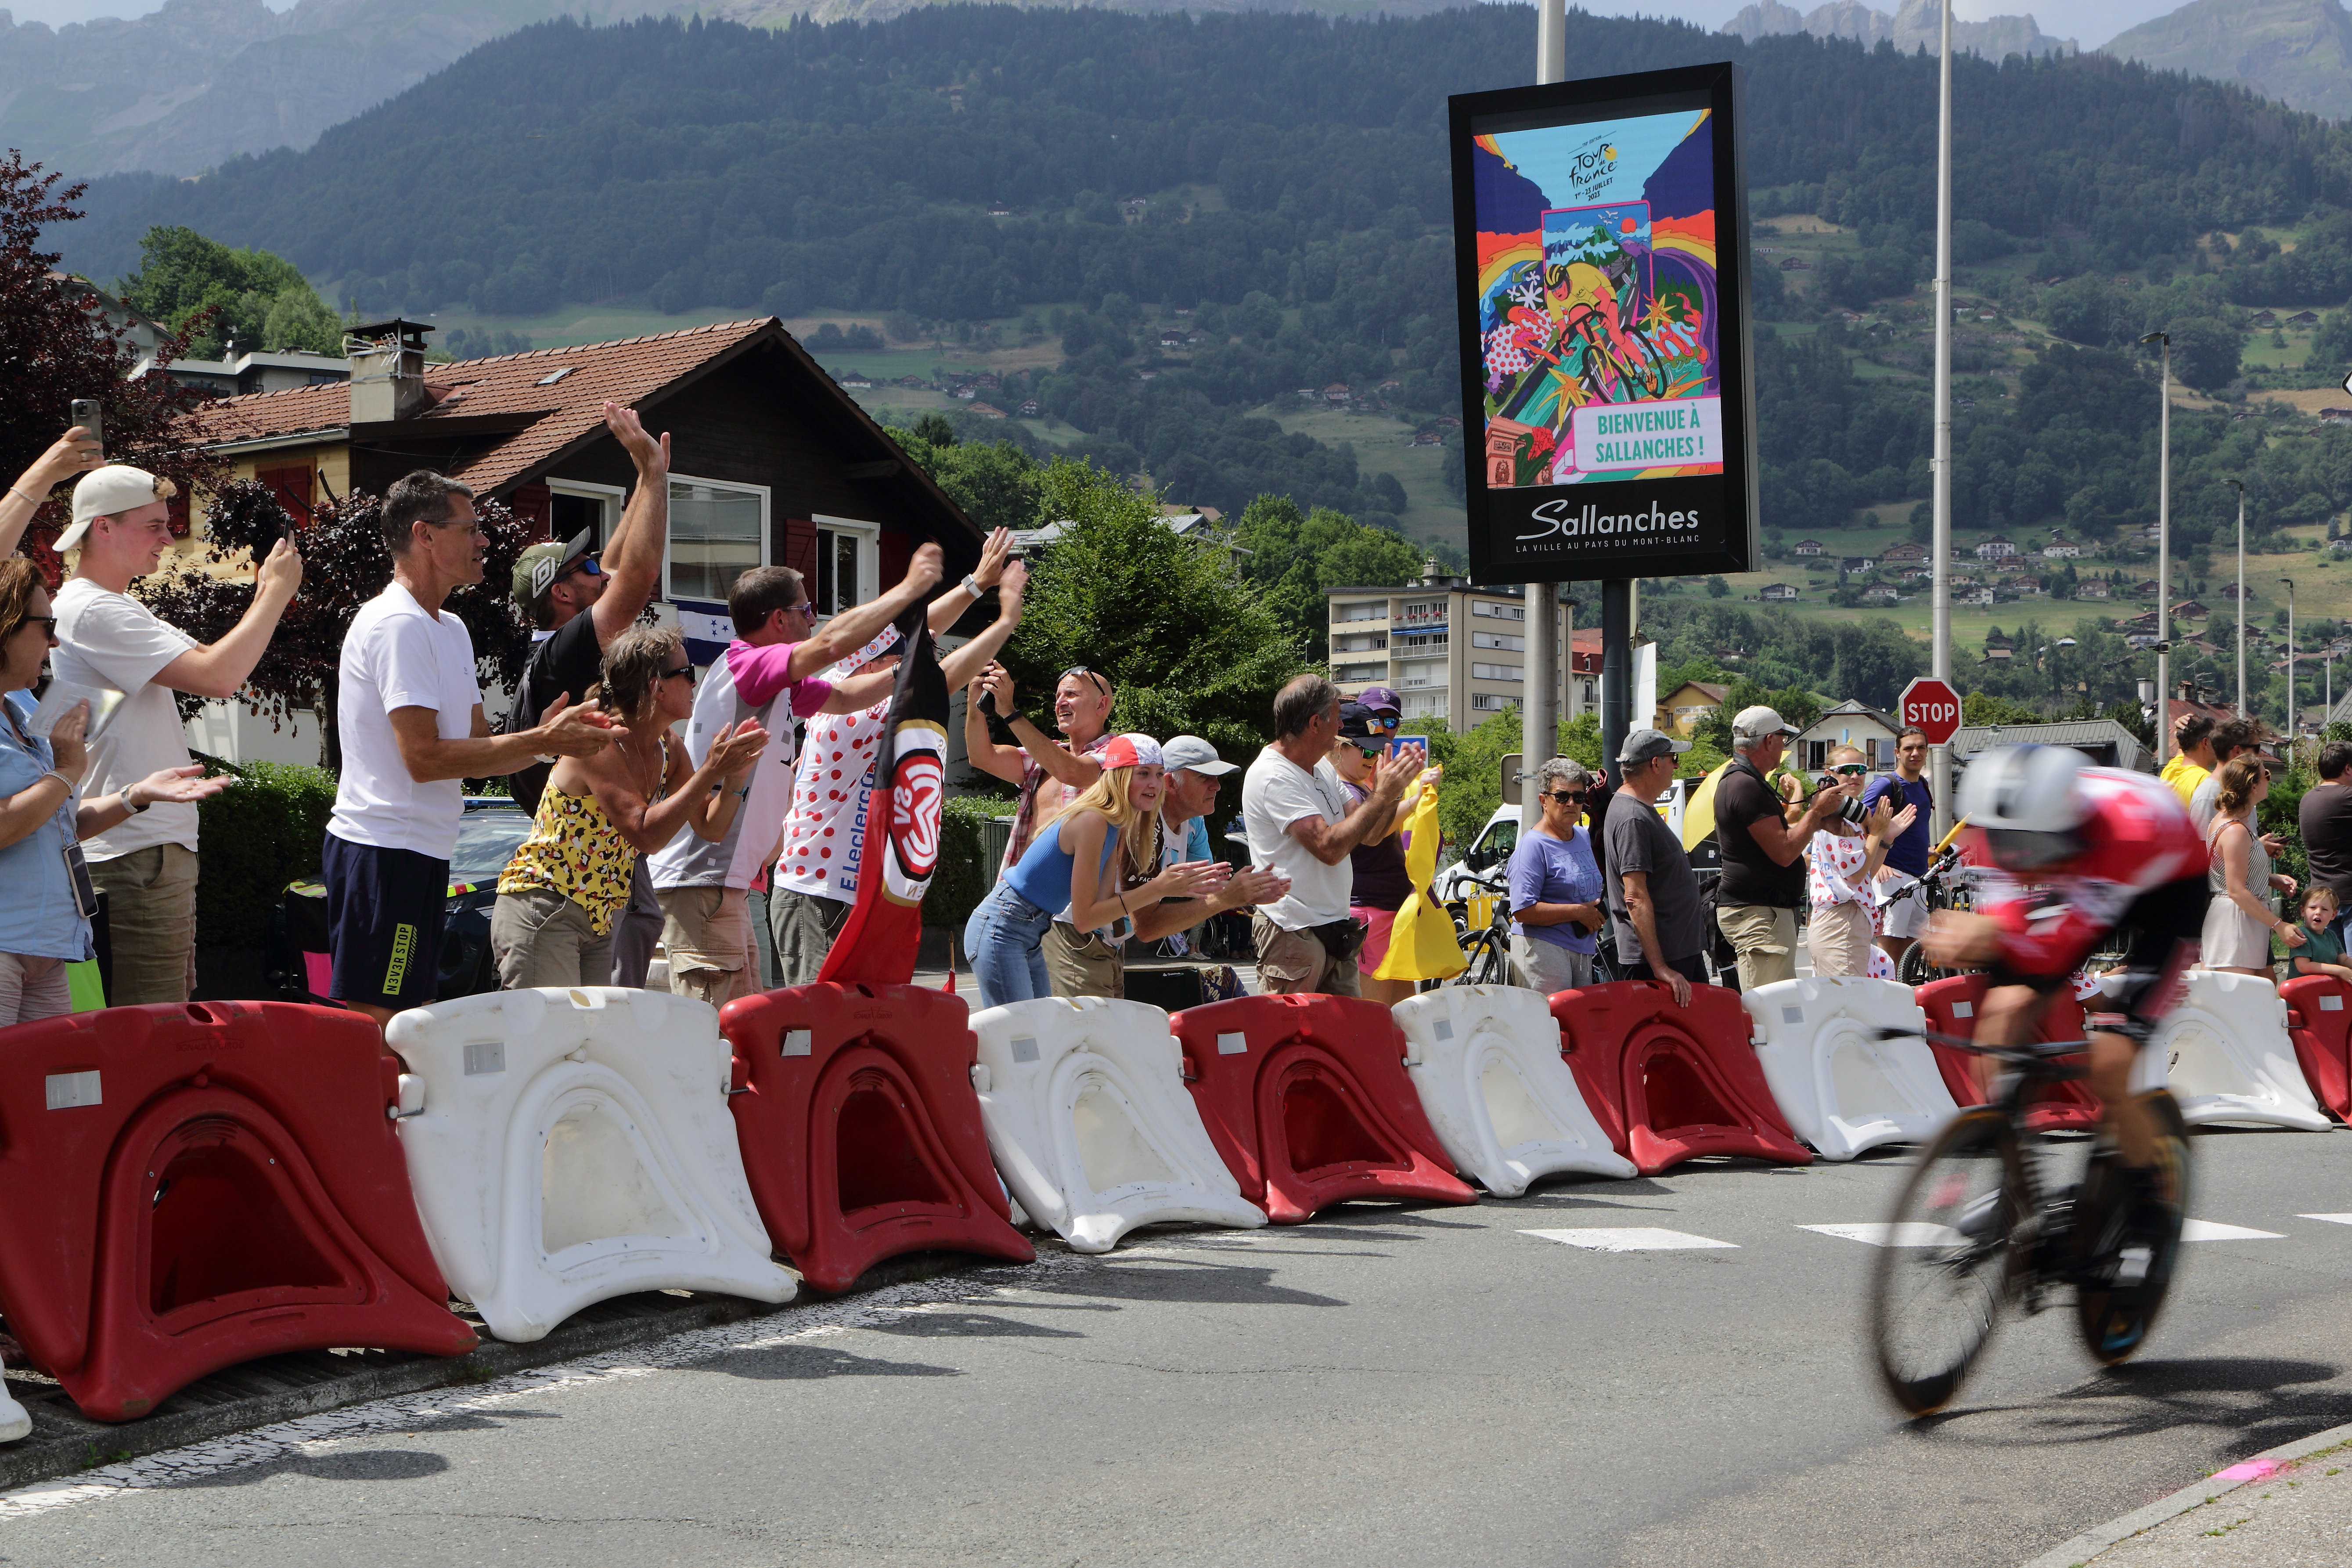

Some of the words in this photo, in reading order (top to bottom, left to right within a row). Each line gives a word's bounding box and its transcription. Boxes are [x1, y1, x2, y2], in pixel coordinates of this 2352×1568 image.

[1585, 187, 1591, 195] 23
[1592, 177, 1613, 192] JUILLET
[1588, 190, 1600, 201] 2023
[1598, 409, 1686, 435] BIENVENUE
[1690, 402, 1700, 429] À
[1596, 436, 1694, 463] SALLANCHES
[1699, 436, 1704, 456] !
[1516, 499, 1699, 540] Sallanches
[1533, 543, 1561, 552] VILLE
[1585, 539, 1609, 548] PAYS
[1633, 535, 1700, 545] MONT-BLANC
[1908, 703, 1955, 722] STOP
[1672, 806, 1677, 816] 1
[386, 957, 405, 991] N3V3R
[396, 927, 409, 954] STOP
